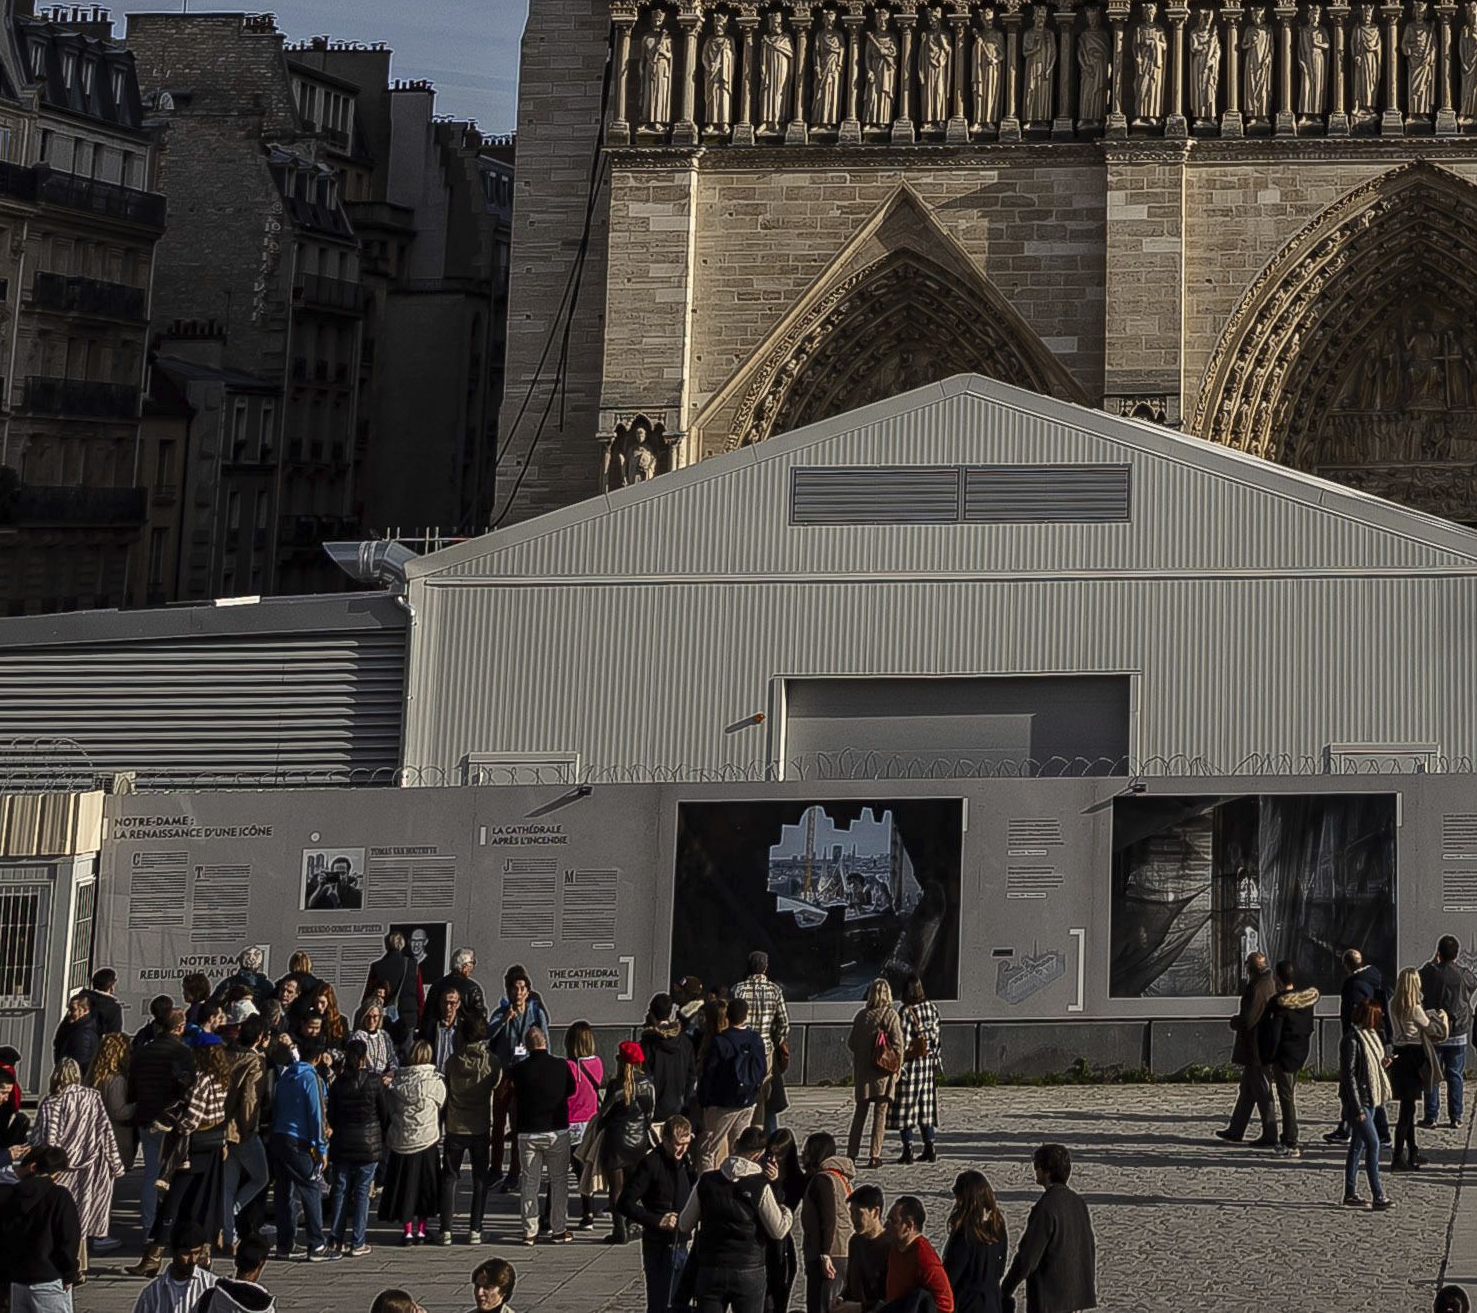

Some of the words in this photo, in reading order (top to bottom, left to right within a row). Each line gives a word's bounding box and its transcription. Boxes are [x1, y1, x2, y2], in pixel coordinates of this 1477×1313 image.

[113, 829, 127, 840] LA
[129, 827, 203, 840] RENAISSANCE
[204, 827, 237, 838] D'UNE
[238, 824, 273, 837] ICÔNE
[492, 827, 504, 835] LA
[505, 824, 562, 834] CATHÉDRALE
[491, 835, 519, 845] APRÈS
[520, 835, 568, 845] L'INCENDIE
[179, 955, 217, 967] NOTRE
[207, 967, 224, 979] AN
[548, 969, 566, 979] THE
[567, 968, 620, 978] CATHEDRAL
[551, 980, 579, 989] AFTER
[581, 979, 599, 989] THE
[600, 979, 619, 988] FIRE
